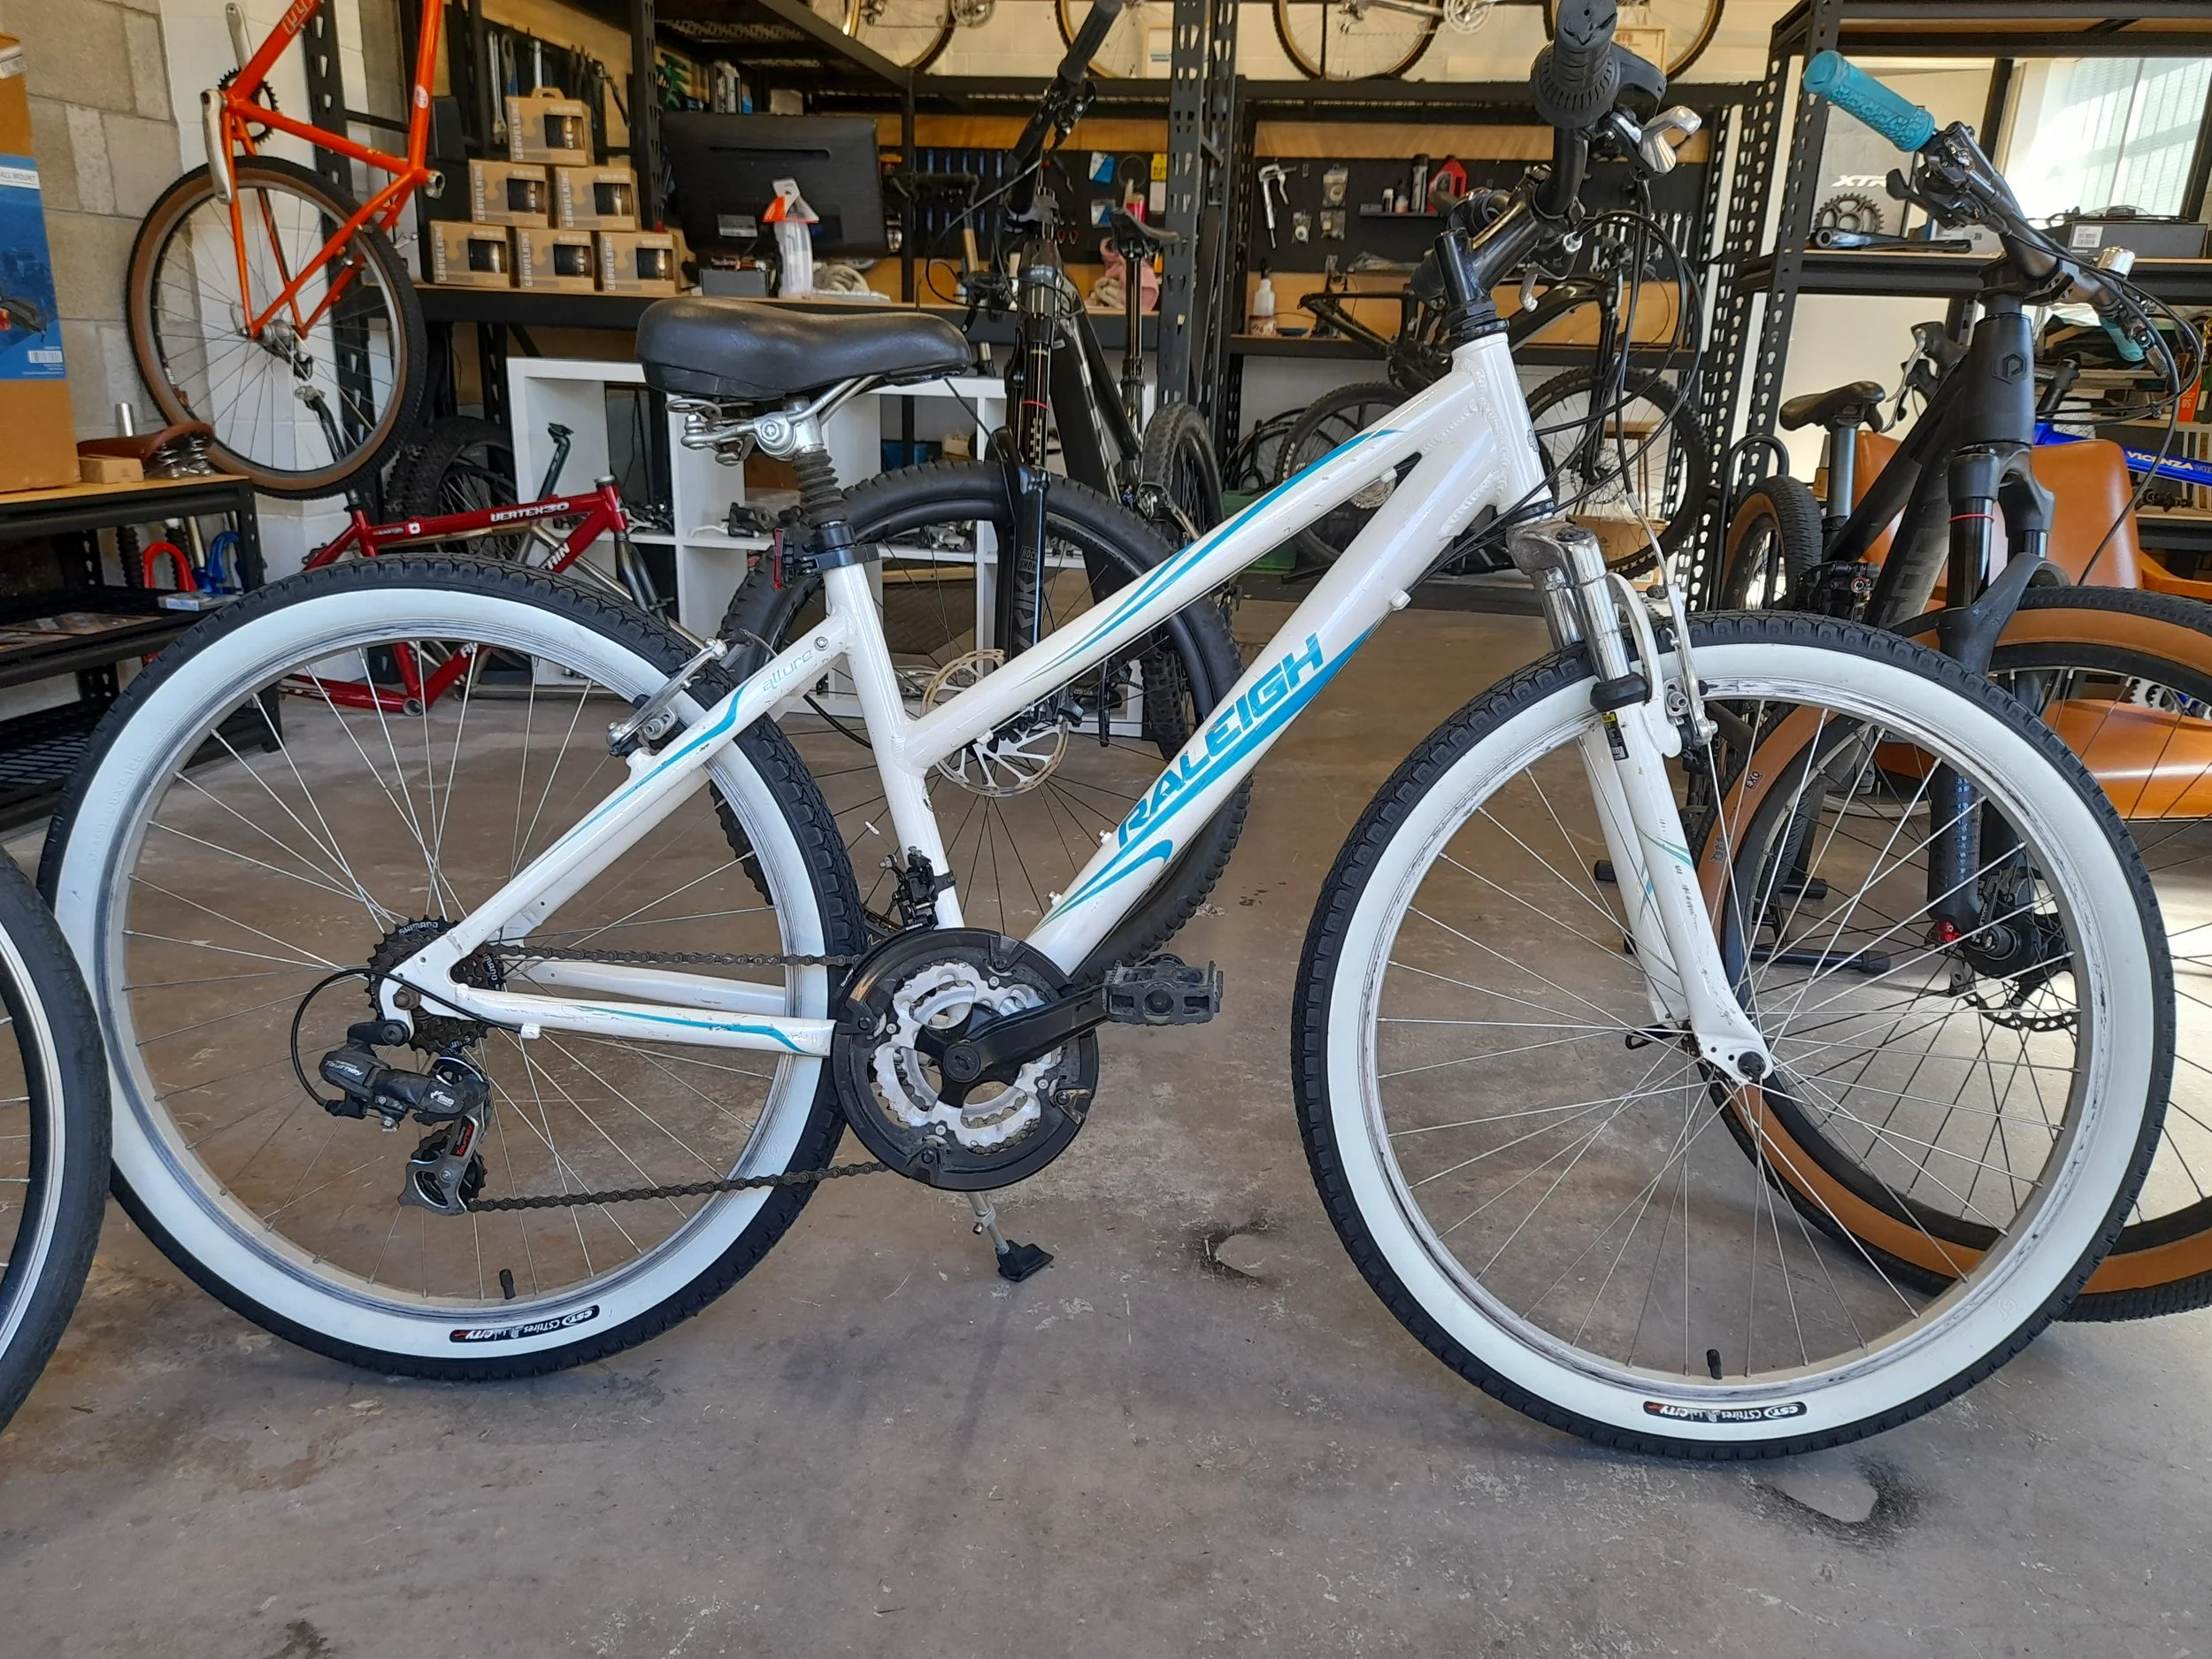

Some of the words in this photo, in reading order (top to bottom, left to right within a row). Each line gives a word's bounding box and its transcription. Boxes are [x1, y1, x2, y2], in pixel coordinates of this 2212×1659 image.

[511, 101, 525, 161] GRAVELKING
[475, 165, 487, 222] GRAVELKING
[561, 169, 574, 228] GRAVELKING
[434, 227, 447, 282] GRAVELKING
[521, 231, 534, 288] GRAVELKING
[604, 235, 617, 292] GRAVELKING
[763, 649, 813, 692] allure
[1118, 633, 1324, 849] RALEIGH
[1745, 771, 1760, 789] EXO
[399, 921, 439, 935] SHIMANO
[483, 953, 499, 981] IMANO
[325, 1060, 364, 1076] Tourney
[456, 1124, 473, 1156] Tourney
[465, 1329, 494, 1340] CITY
[1659, 1405, 1689, 1417] CITY
